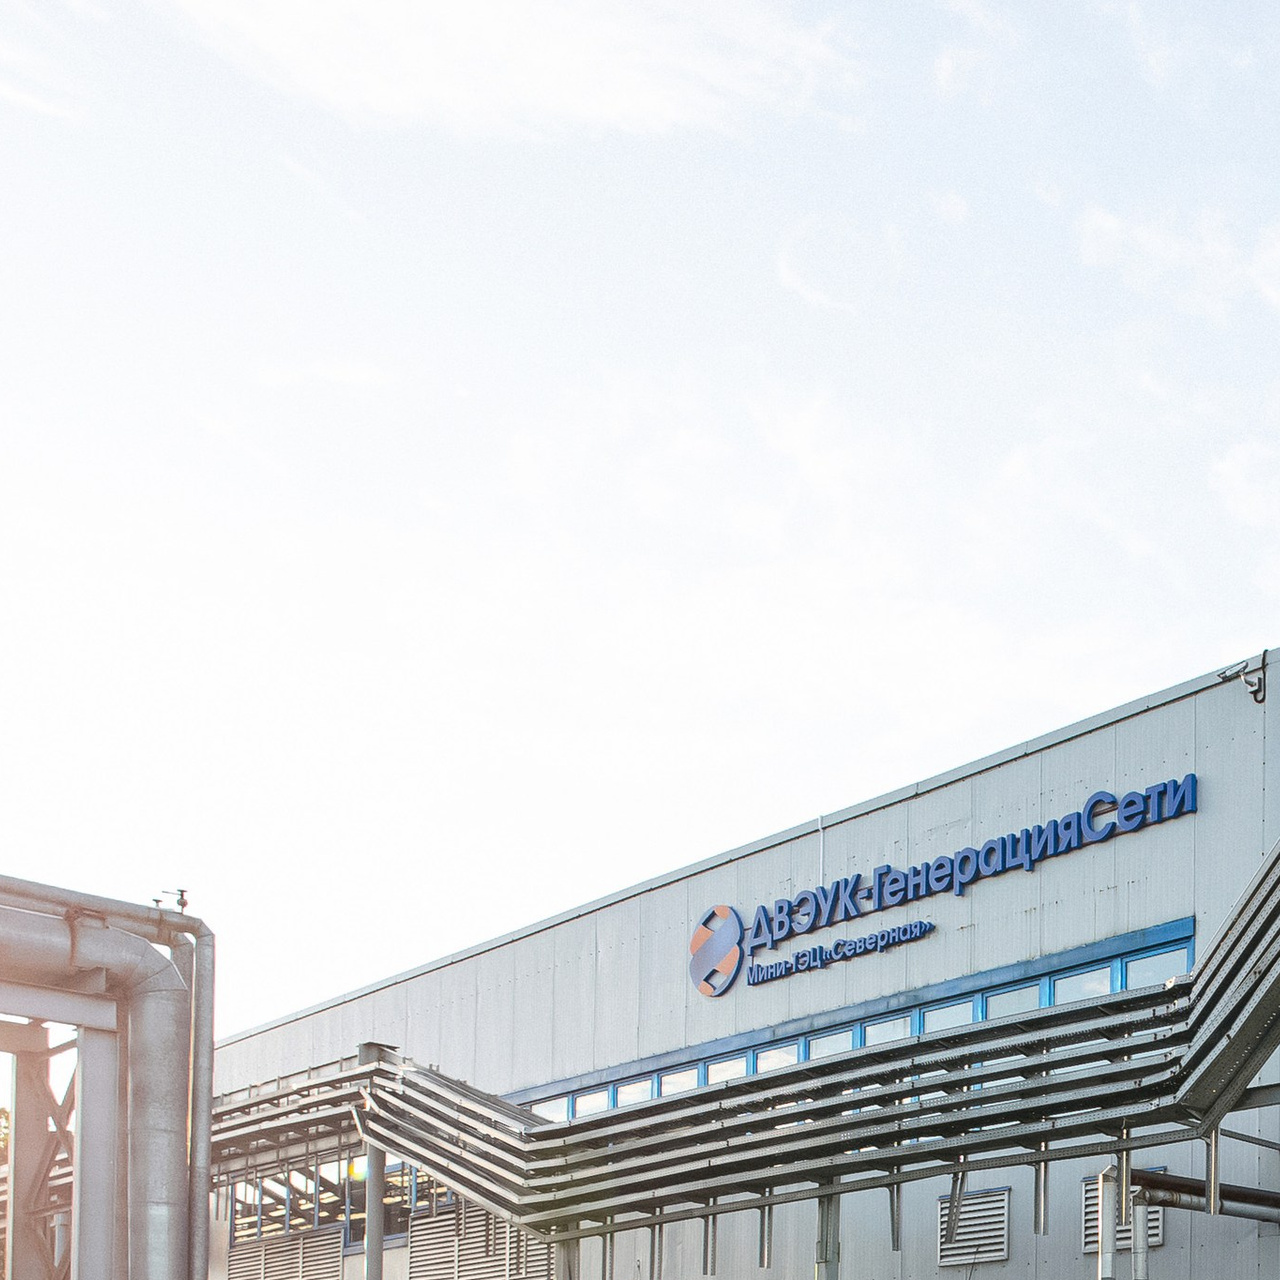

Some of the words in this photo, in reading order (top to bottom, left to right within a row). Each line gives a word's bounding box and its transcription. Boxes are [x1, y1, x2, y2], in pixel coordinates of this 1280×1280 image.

[747, 773, 1197, 957] ДВЭУК-ГенерацияСети
[747, 945, 824, 986] Мини-ТЭЦ
[821, 920, 936, 962] «Северная»
